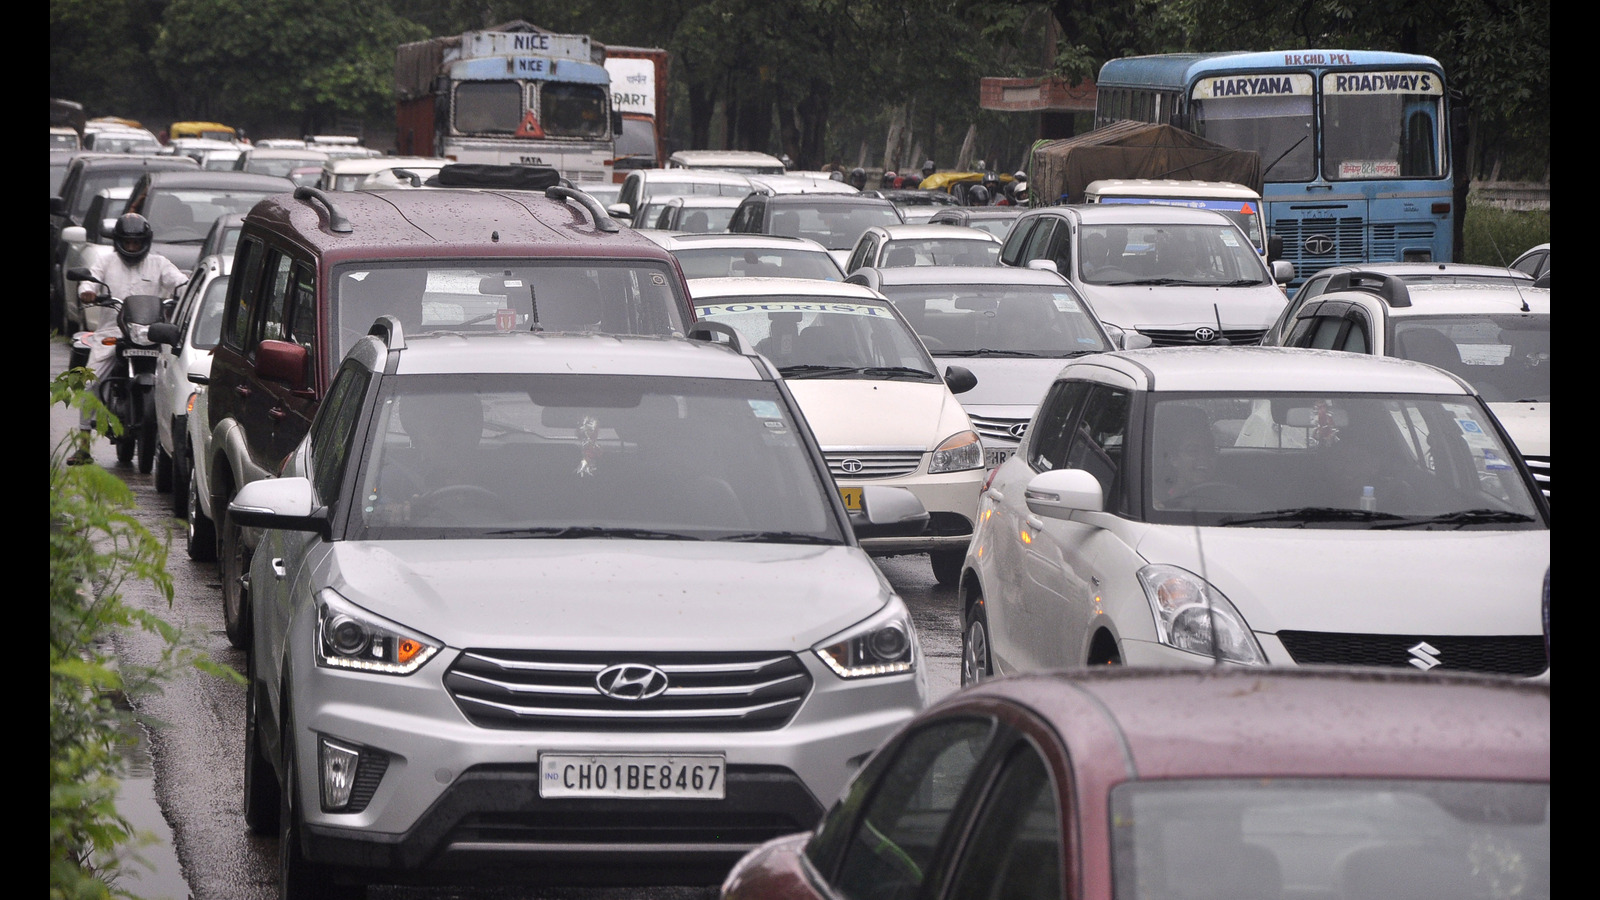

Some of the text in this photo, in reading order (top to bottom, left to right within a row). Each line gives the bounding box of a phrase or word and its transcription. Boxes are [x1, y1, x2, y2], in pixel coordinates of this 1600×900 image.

[514, 34, 549, 50] NICE
[519, 59, 543, 72] NICE
[1213, 74, 1432, 97] HARYANA ROADWAYS
[613, 92, 647, 106] DART
[520, 156, 542, 164] TATA
[696, 304, 886, 317] TOURIST
[563, 764, 721, 791] CH01BE8467
